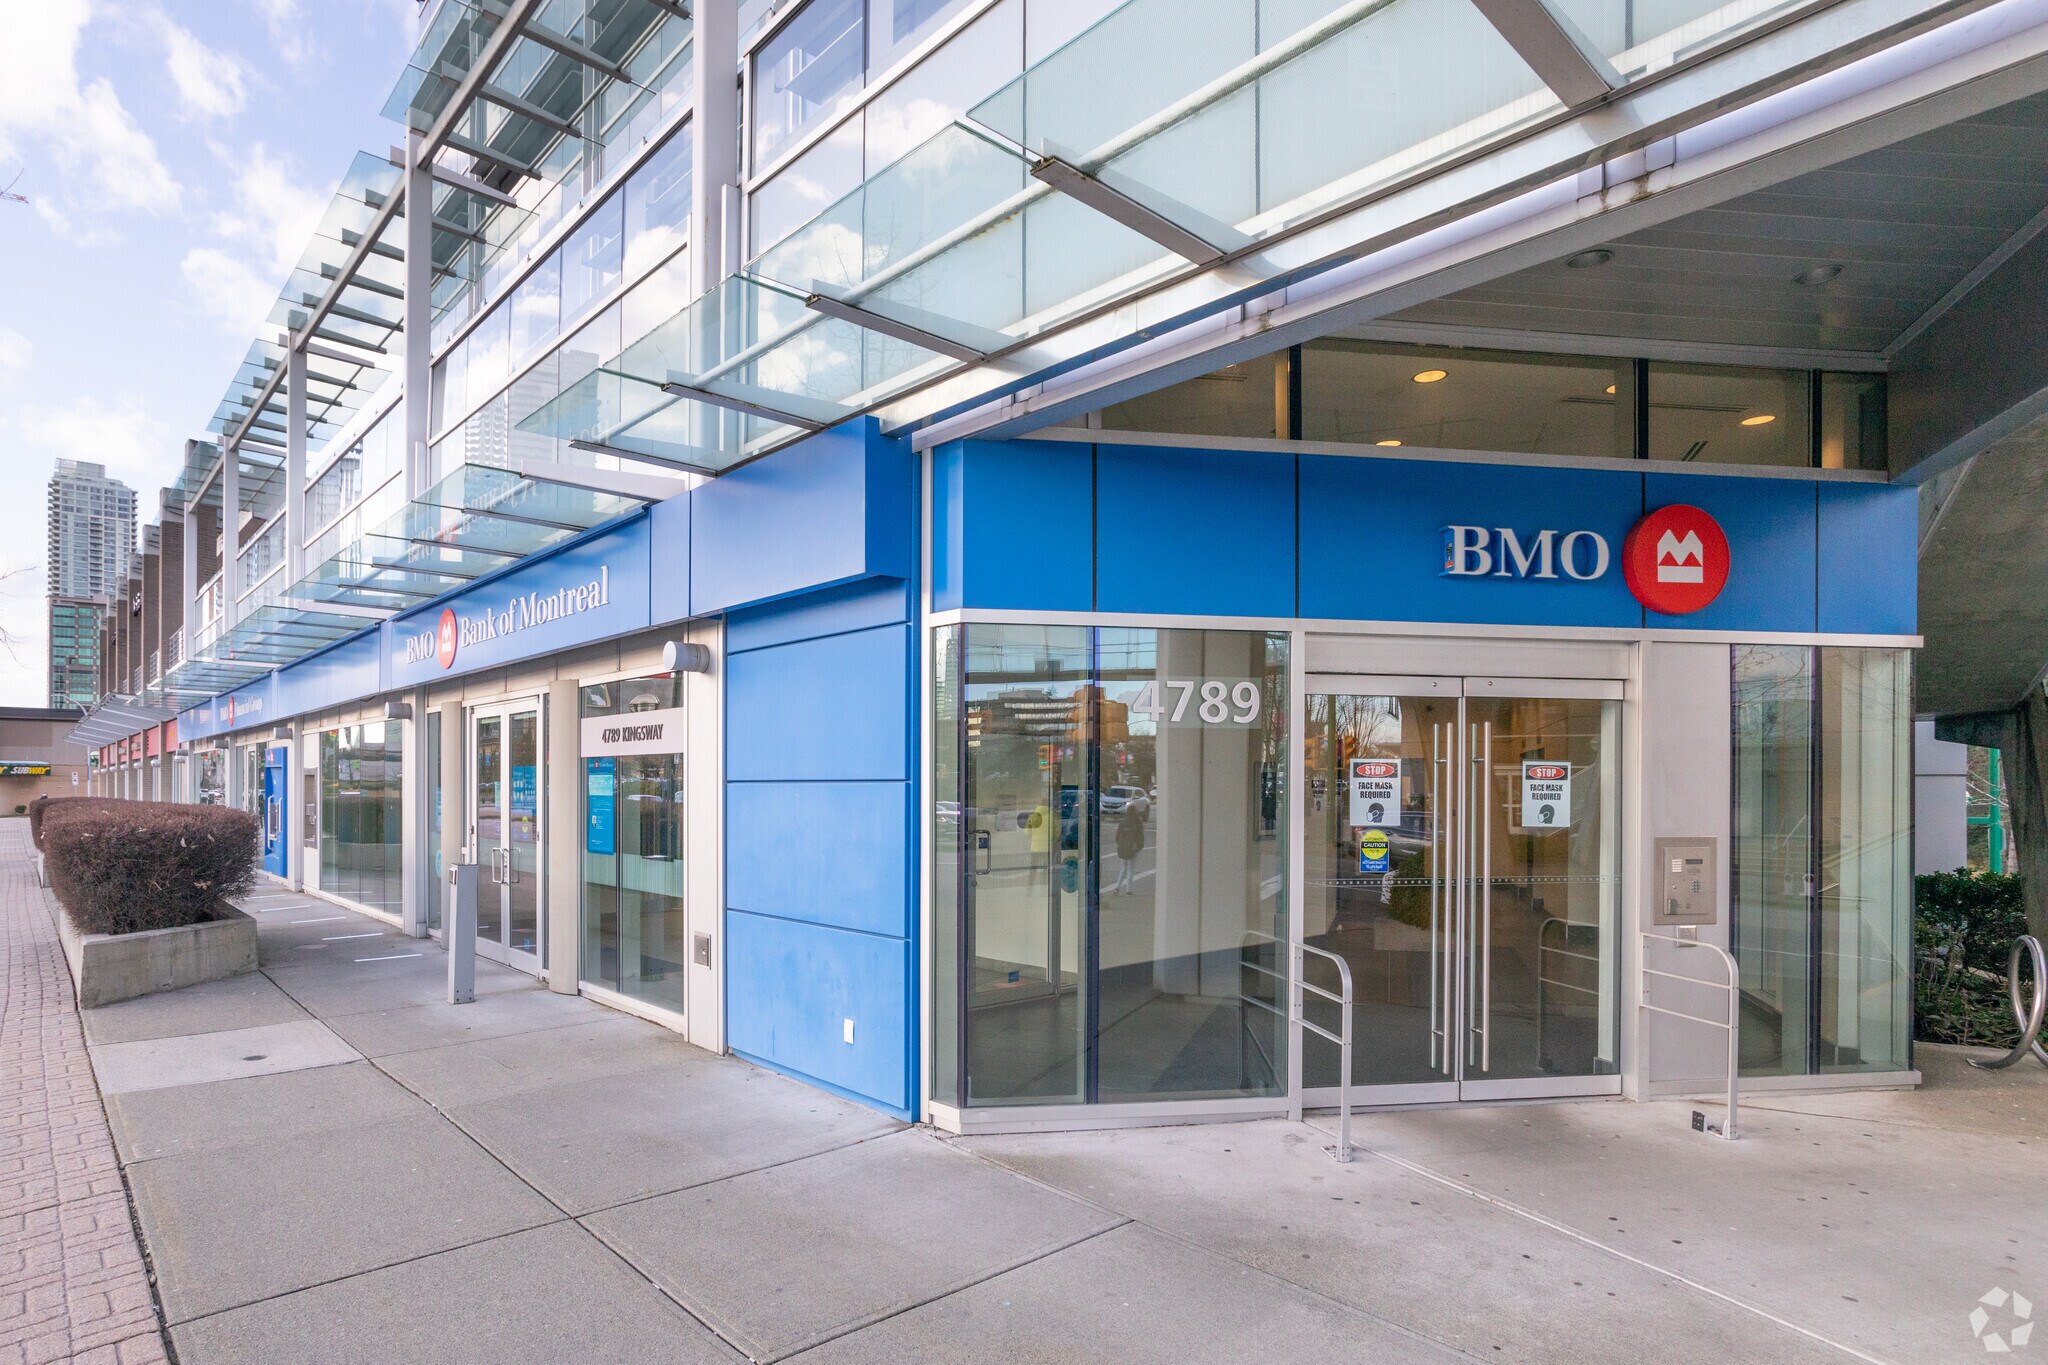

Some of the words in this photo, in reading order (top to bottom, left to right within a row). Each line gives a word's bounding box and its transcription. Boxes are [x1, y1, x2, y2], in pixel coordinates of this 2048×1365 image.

[1446, 525, 1610, 580] BMO
[406, 631, 434, 664] BMO
[461, 607, 498, 648] Bank
[500, 598, 517, 636] of
[519, 565, 610, 630] Montreal
[1132, 680, 1260, 724] 4789
[602, 728, 621, 744] 4789
[622, 724, 664, 742] KINGSWAY
[10, 766, 50, 775] SUBWAY
[1365, 765, 1386, 775] STOP
[1536, 768, 1556, 777] STOP
[1358, 782, 1374, 790] FACE
[1375, 782, 1393, 790] MASK
[1530, 784, 1545, 792] FACE
[1545, 784, 1563, 792] MASK
[1360, 791, 1391, 800] REQUIRED
[1531, 793, 1561, 801] REQUIRED
